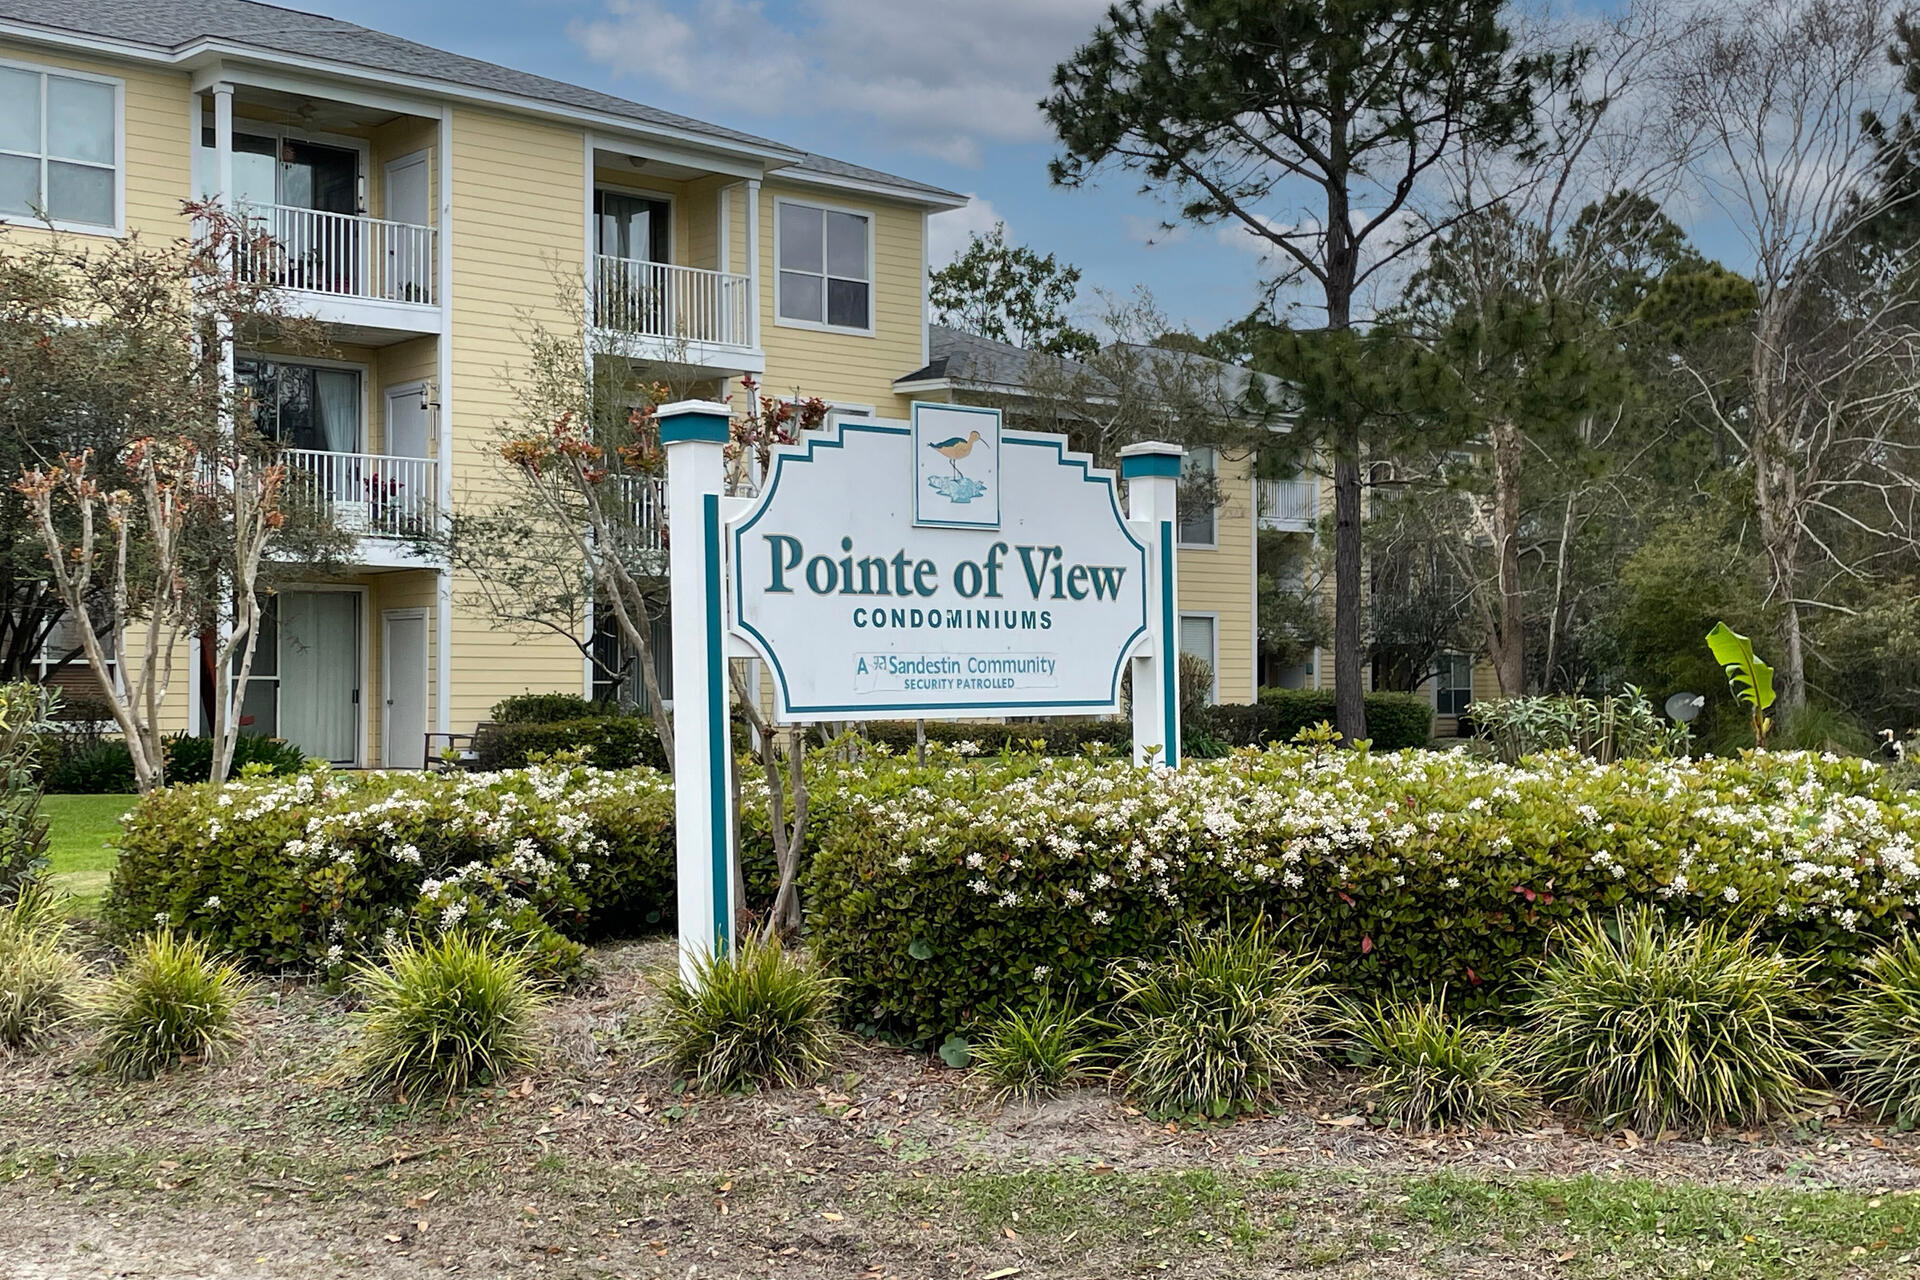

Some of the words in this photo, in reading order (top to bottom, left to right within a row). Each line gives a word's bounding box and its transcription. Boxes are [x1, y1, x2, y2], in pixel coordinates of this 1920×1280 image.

[762, 533, 938, 597] Pointe
[952, 541, 1008, 599] of
[1015, 544, 1126, 601] View
[853, 607, 1052, 630] CONDOMINIUMS
[857, 656, 869, 675] A
[889, 655, 960, 675] Sandestin
[968, 656, 1056, 676] Community
[904, 678, 953, 690] SECURITY
[957, 677, 1015, 690] PATROLLED
